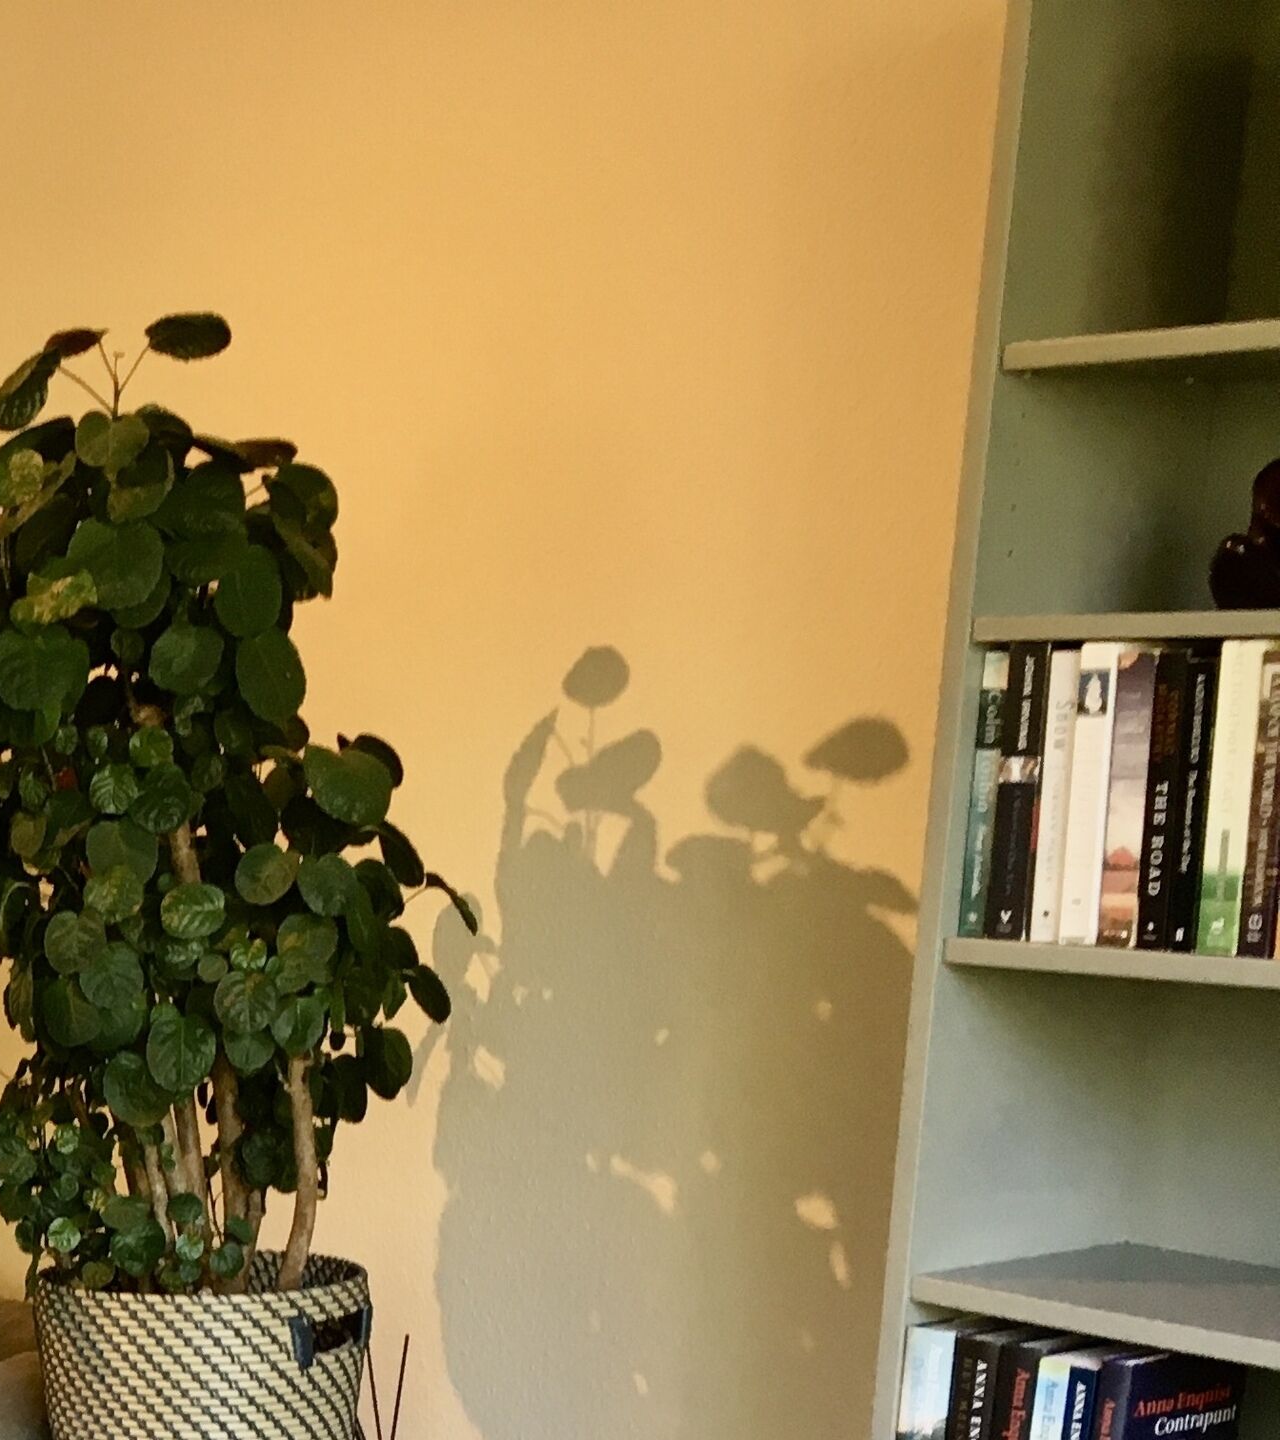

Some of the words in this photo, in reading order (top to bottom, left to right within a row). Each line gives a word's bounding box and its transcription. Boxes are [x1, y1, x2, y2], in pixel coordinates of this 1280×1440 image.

[1154, 781, 1169, 826] THE
[1148, 836, 1164, 896] ROAD
[973, 1359, 988, 1410] ANNA
[1014, 1369, 1030, 1406] Anna
[1072, 1381, 1086, 1420] ANNA
[1133, 1398, 1175, 1418] Anna
[1176, 1385, 1232, 1411] Enquist
[1154, 1403, 1238, 1436] Contrapunt
